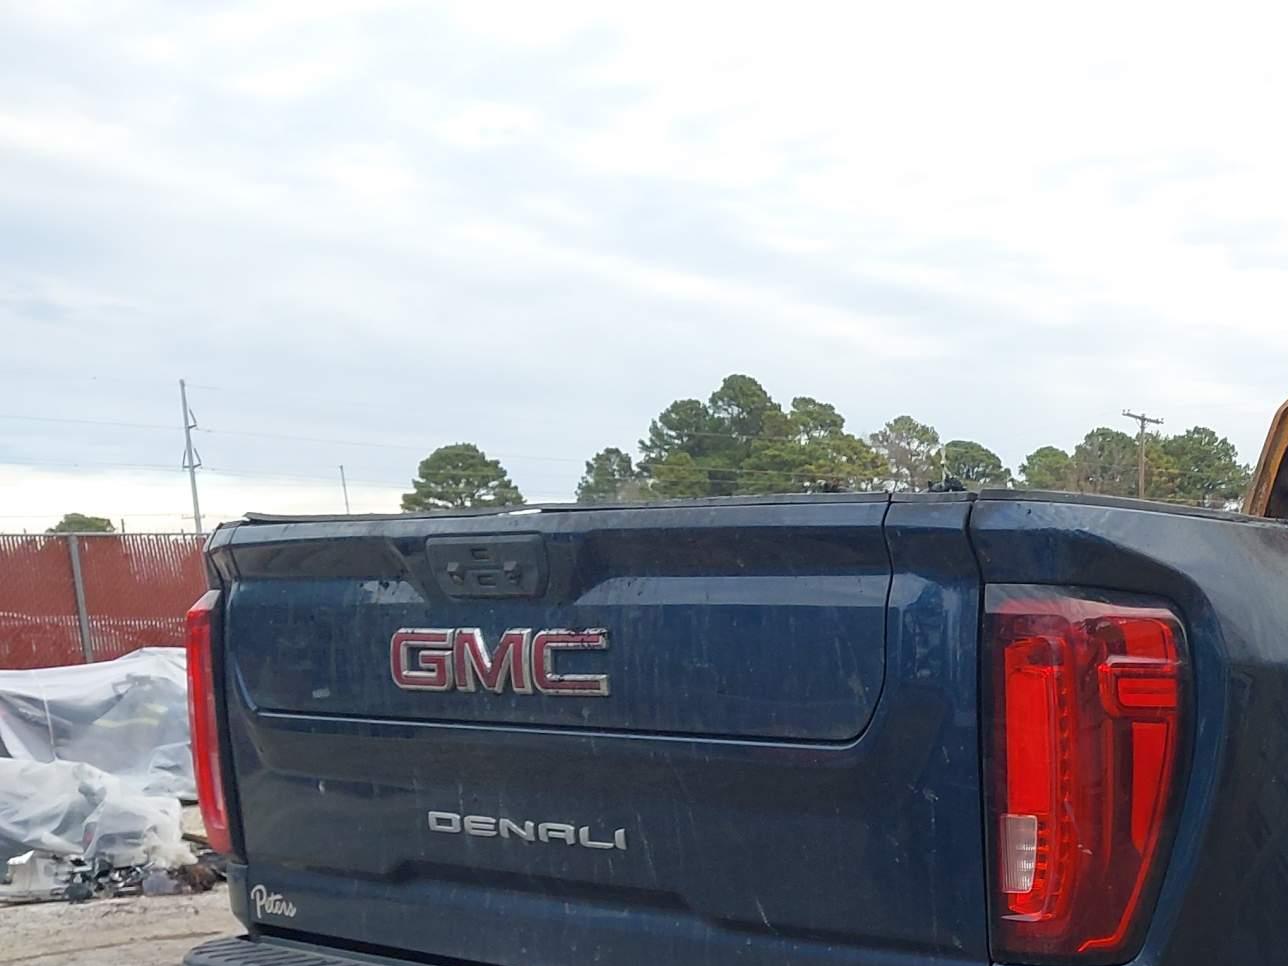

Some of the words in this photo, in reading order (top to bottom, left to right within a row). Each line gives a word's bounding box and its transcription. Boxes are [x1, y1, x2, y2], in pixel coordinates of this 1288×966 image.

[390, 627, 609, 696] GMC
[428, 810, 628, 851] DENALI
[250, 884, 297, 919] Peters
